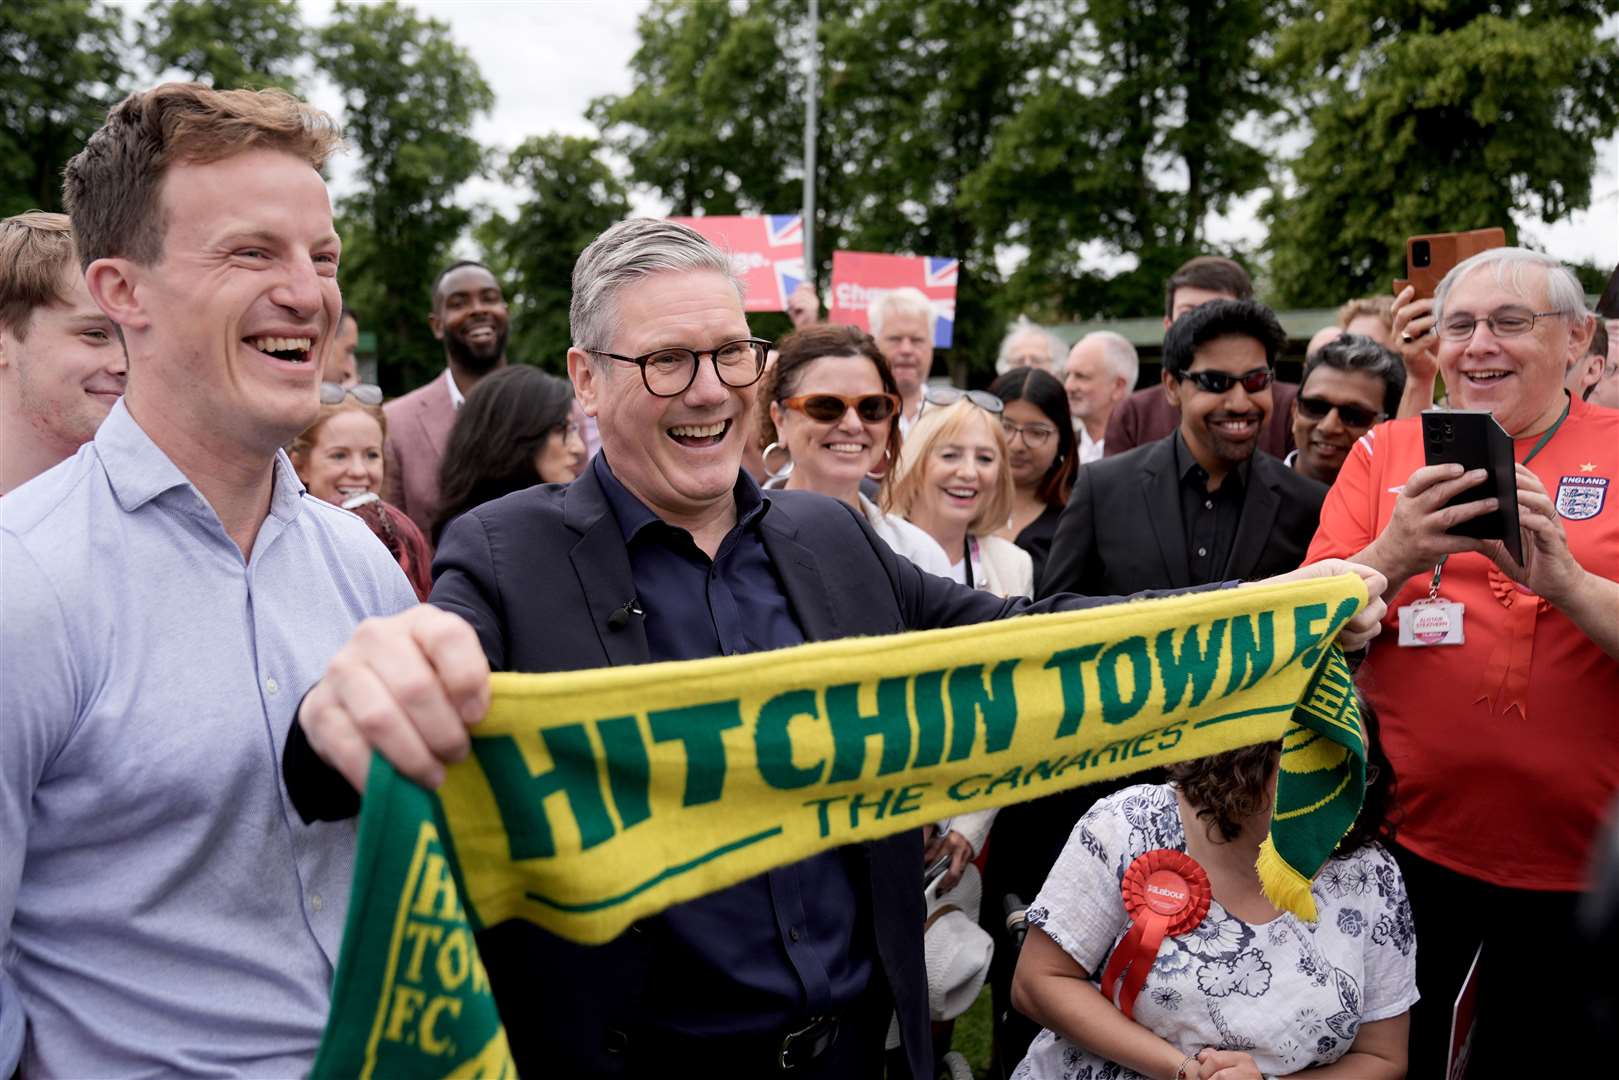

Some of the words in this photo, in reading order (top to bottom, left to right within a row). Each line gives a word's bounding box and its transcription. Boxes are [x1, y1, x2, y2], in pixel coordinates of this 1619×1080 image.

[1562, 477, 1606, 485] ENGLAND
[472, 659, 1018, 861] HITCHIN
[1044, 610, 1276, 739] TOWN
[803, 782, 932, 838] THE
[946, 720, 1189, 801] CANARIES
